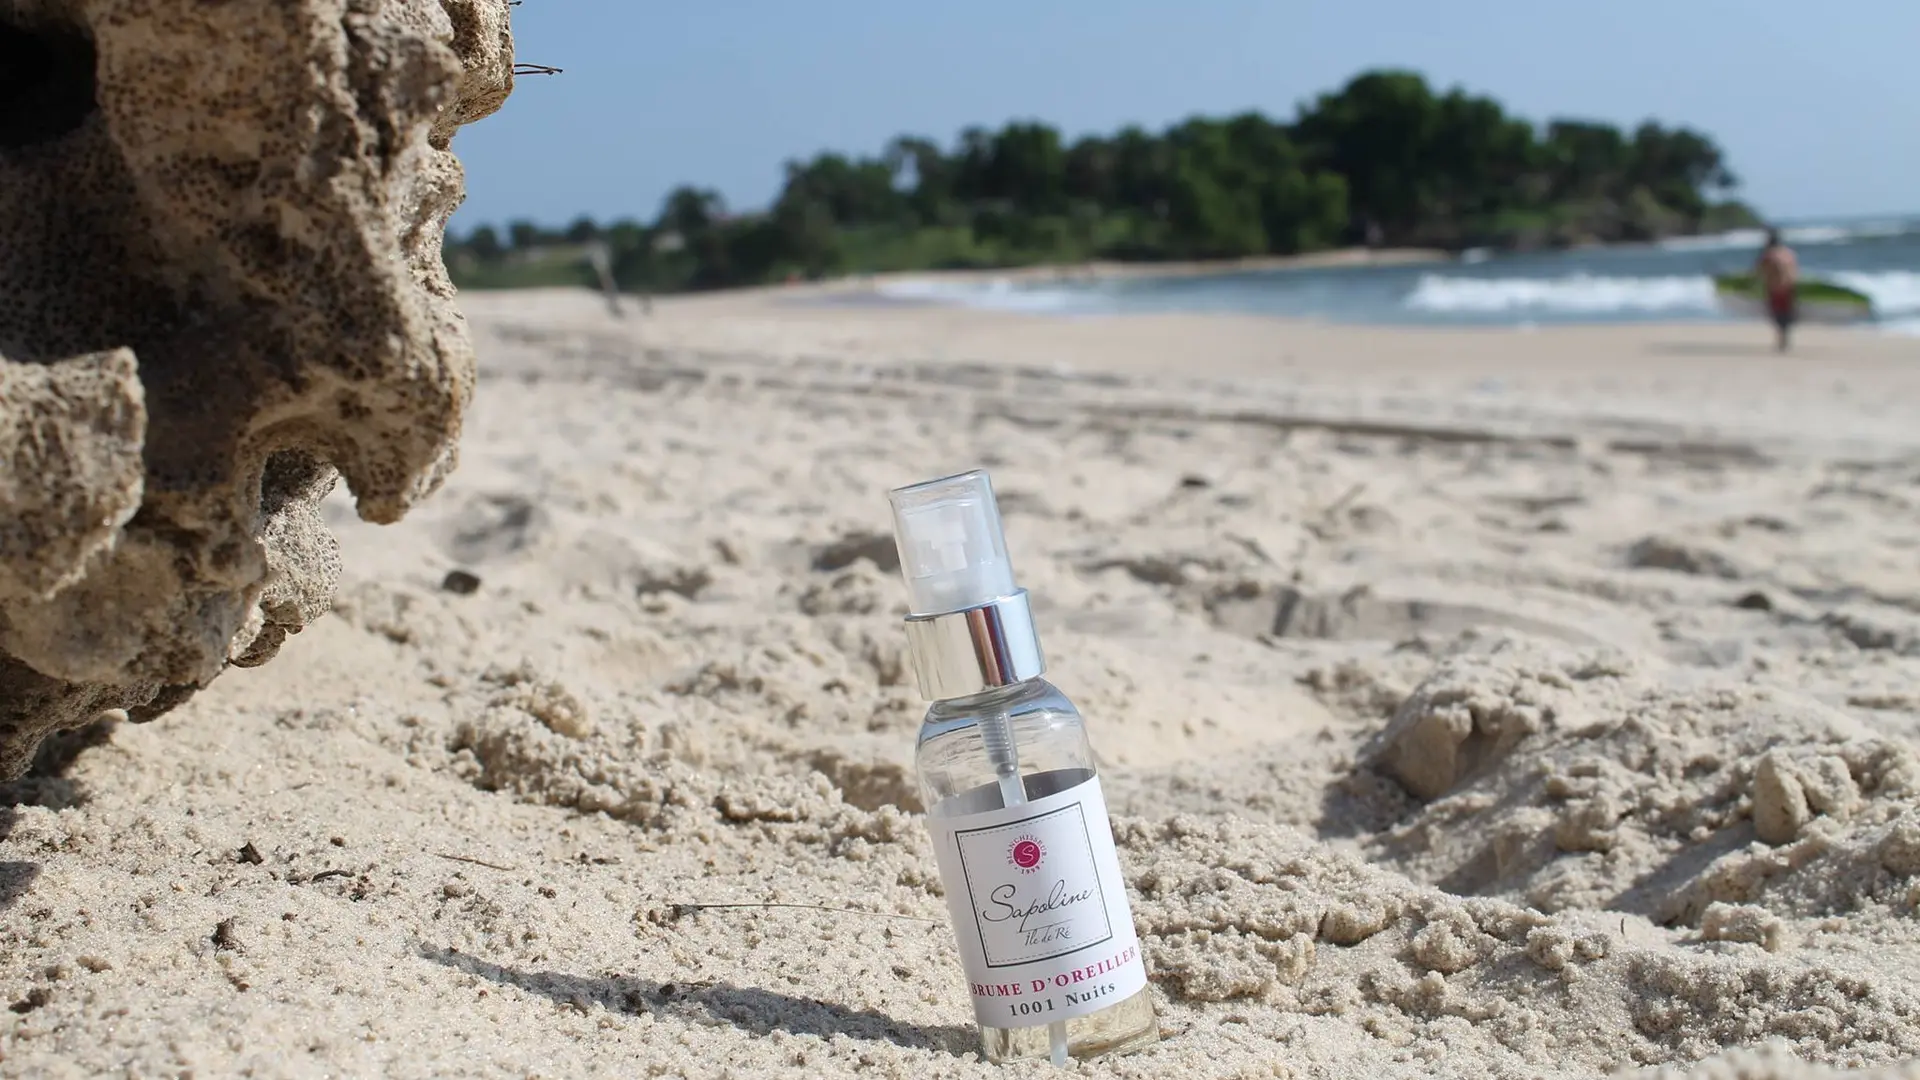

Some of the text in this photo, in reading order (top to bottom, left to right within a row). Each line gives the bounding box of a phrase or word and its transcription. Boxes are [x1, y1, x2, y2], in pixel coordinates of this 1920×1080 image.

[1017, 844, 1035, 864] S
[982, 879, 1094, 933] Sapoline
[1041, 926, 1052, 943] de
[1055, 926, 1073, 940] Ré
[971, 945, 1136, 998] BRUME D'OREILLER
[1010, 981, 1116, 1016] 1001 Nuits
